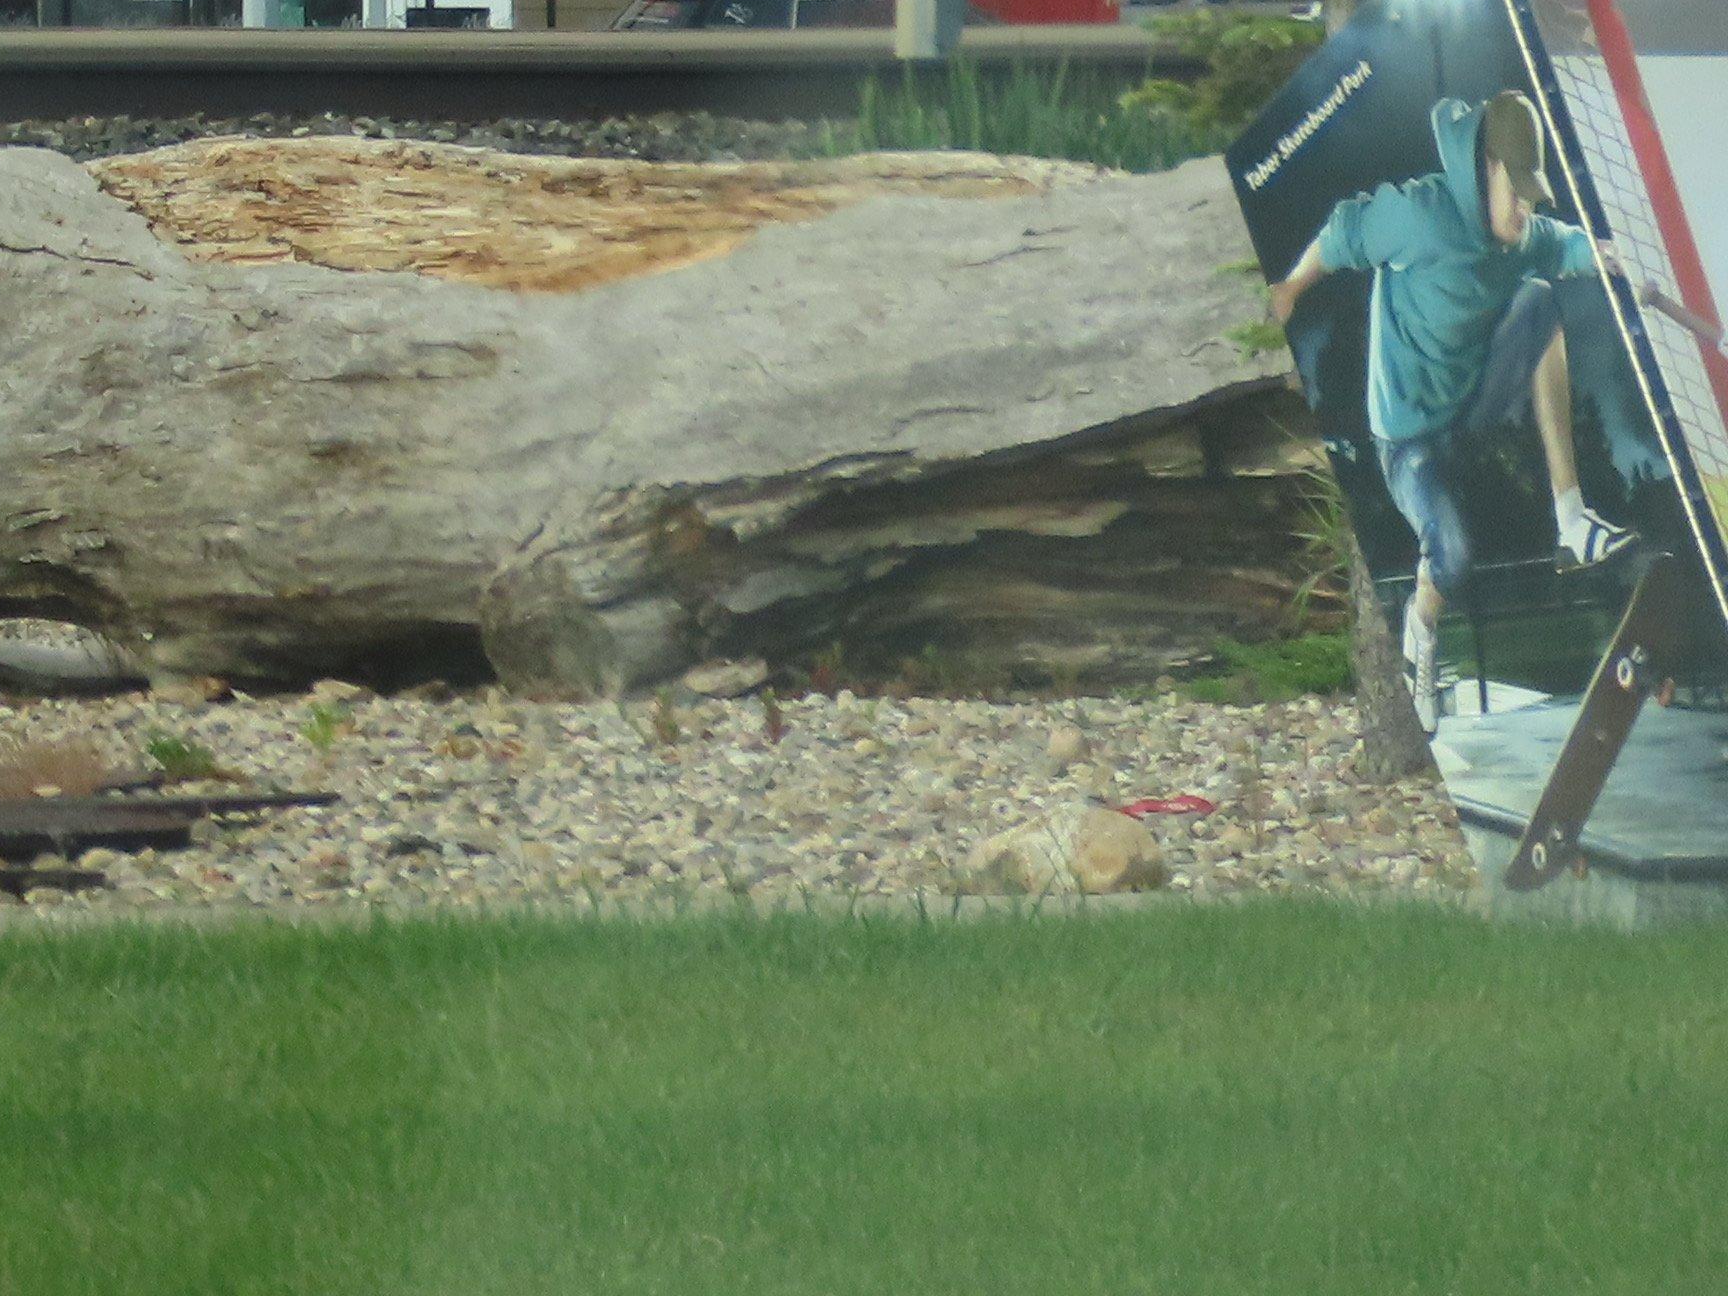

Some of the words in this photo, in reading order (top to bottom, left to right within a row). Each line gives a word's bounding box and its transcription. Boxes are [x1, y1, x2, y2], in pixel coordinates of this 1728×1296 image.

[1244, 153, 1281, 191] Taber
[1277, 85, 1345, 161] Skateboard
[1341, 60, 1373, 96] Park
